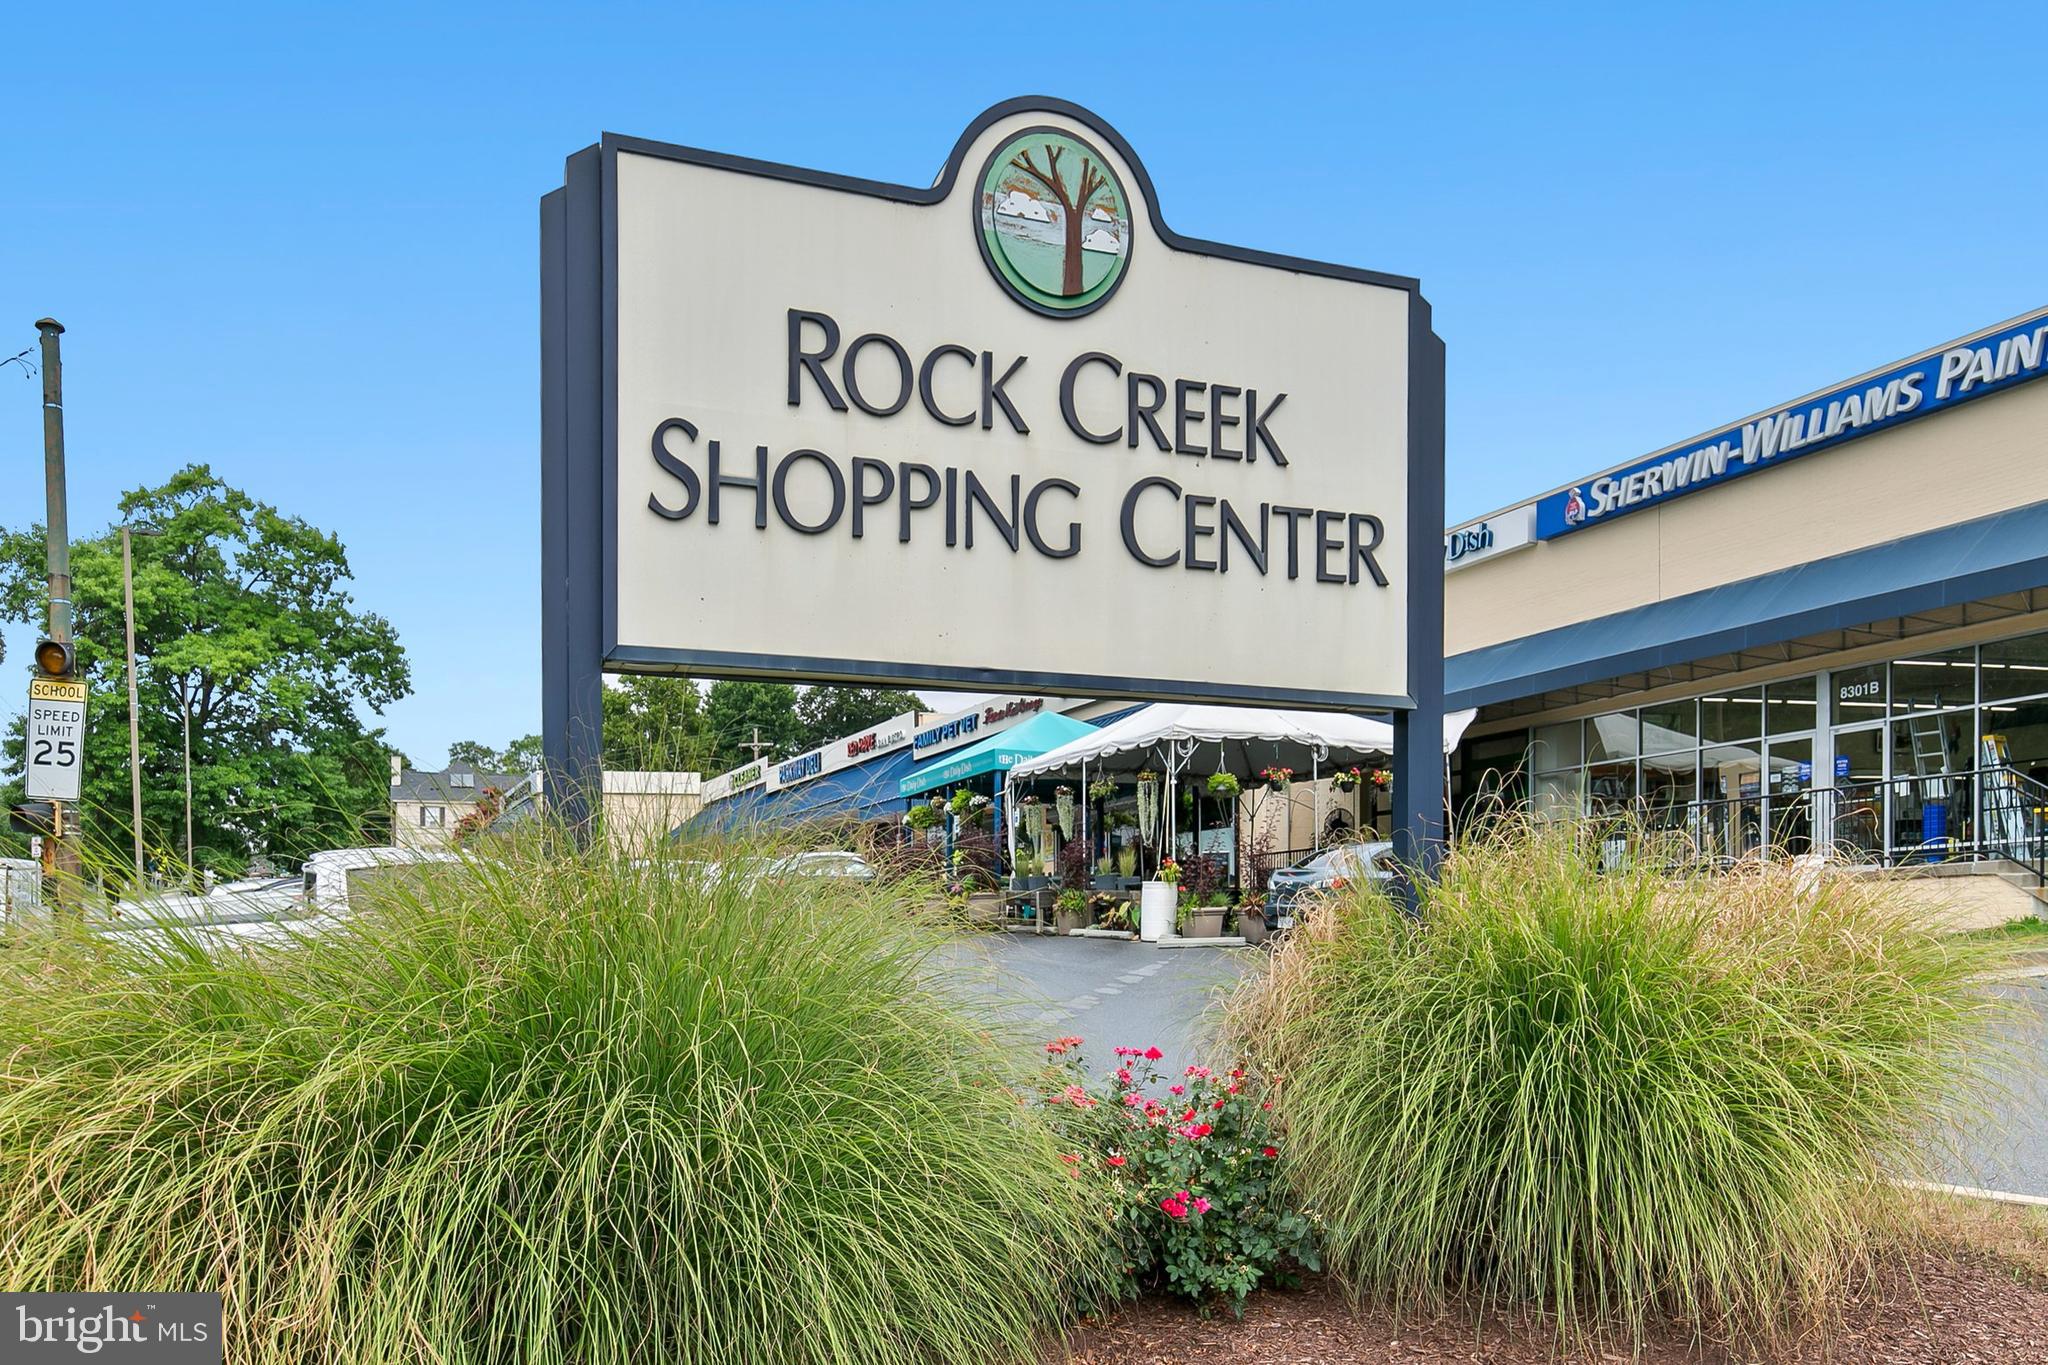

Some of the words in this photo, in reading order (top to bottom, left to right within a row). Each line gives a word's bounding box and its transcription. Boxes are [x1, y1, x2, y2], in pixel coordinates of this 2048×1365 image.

[787, 308, 1031, 436] ROCK
[1058, 351, 1290, 467] CREEK
[1587, 371, 1926, 517] SHERWIN-WILLIAMS
[647, 418, 1083, 560] SHOPPING
[1119, 476, 1390, 587] CENTER
[1447, 523, 1494, 561] Dish
[34, 685, 83, 698] SCHOOL
[1840, 681, 1879, 699] 8301B
[34, 709, 80, 722] SPEED
[37, 725, 73, 737] LIMIT
[913, 726, 943, 750] FAMILY
[942, 719, 960, 741] PET
[960, 713, 979, 735] VET
[33, 739, 75, 767] 25
